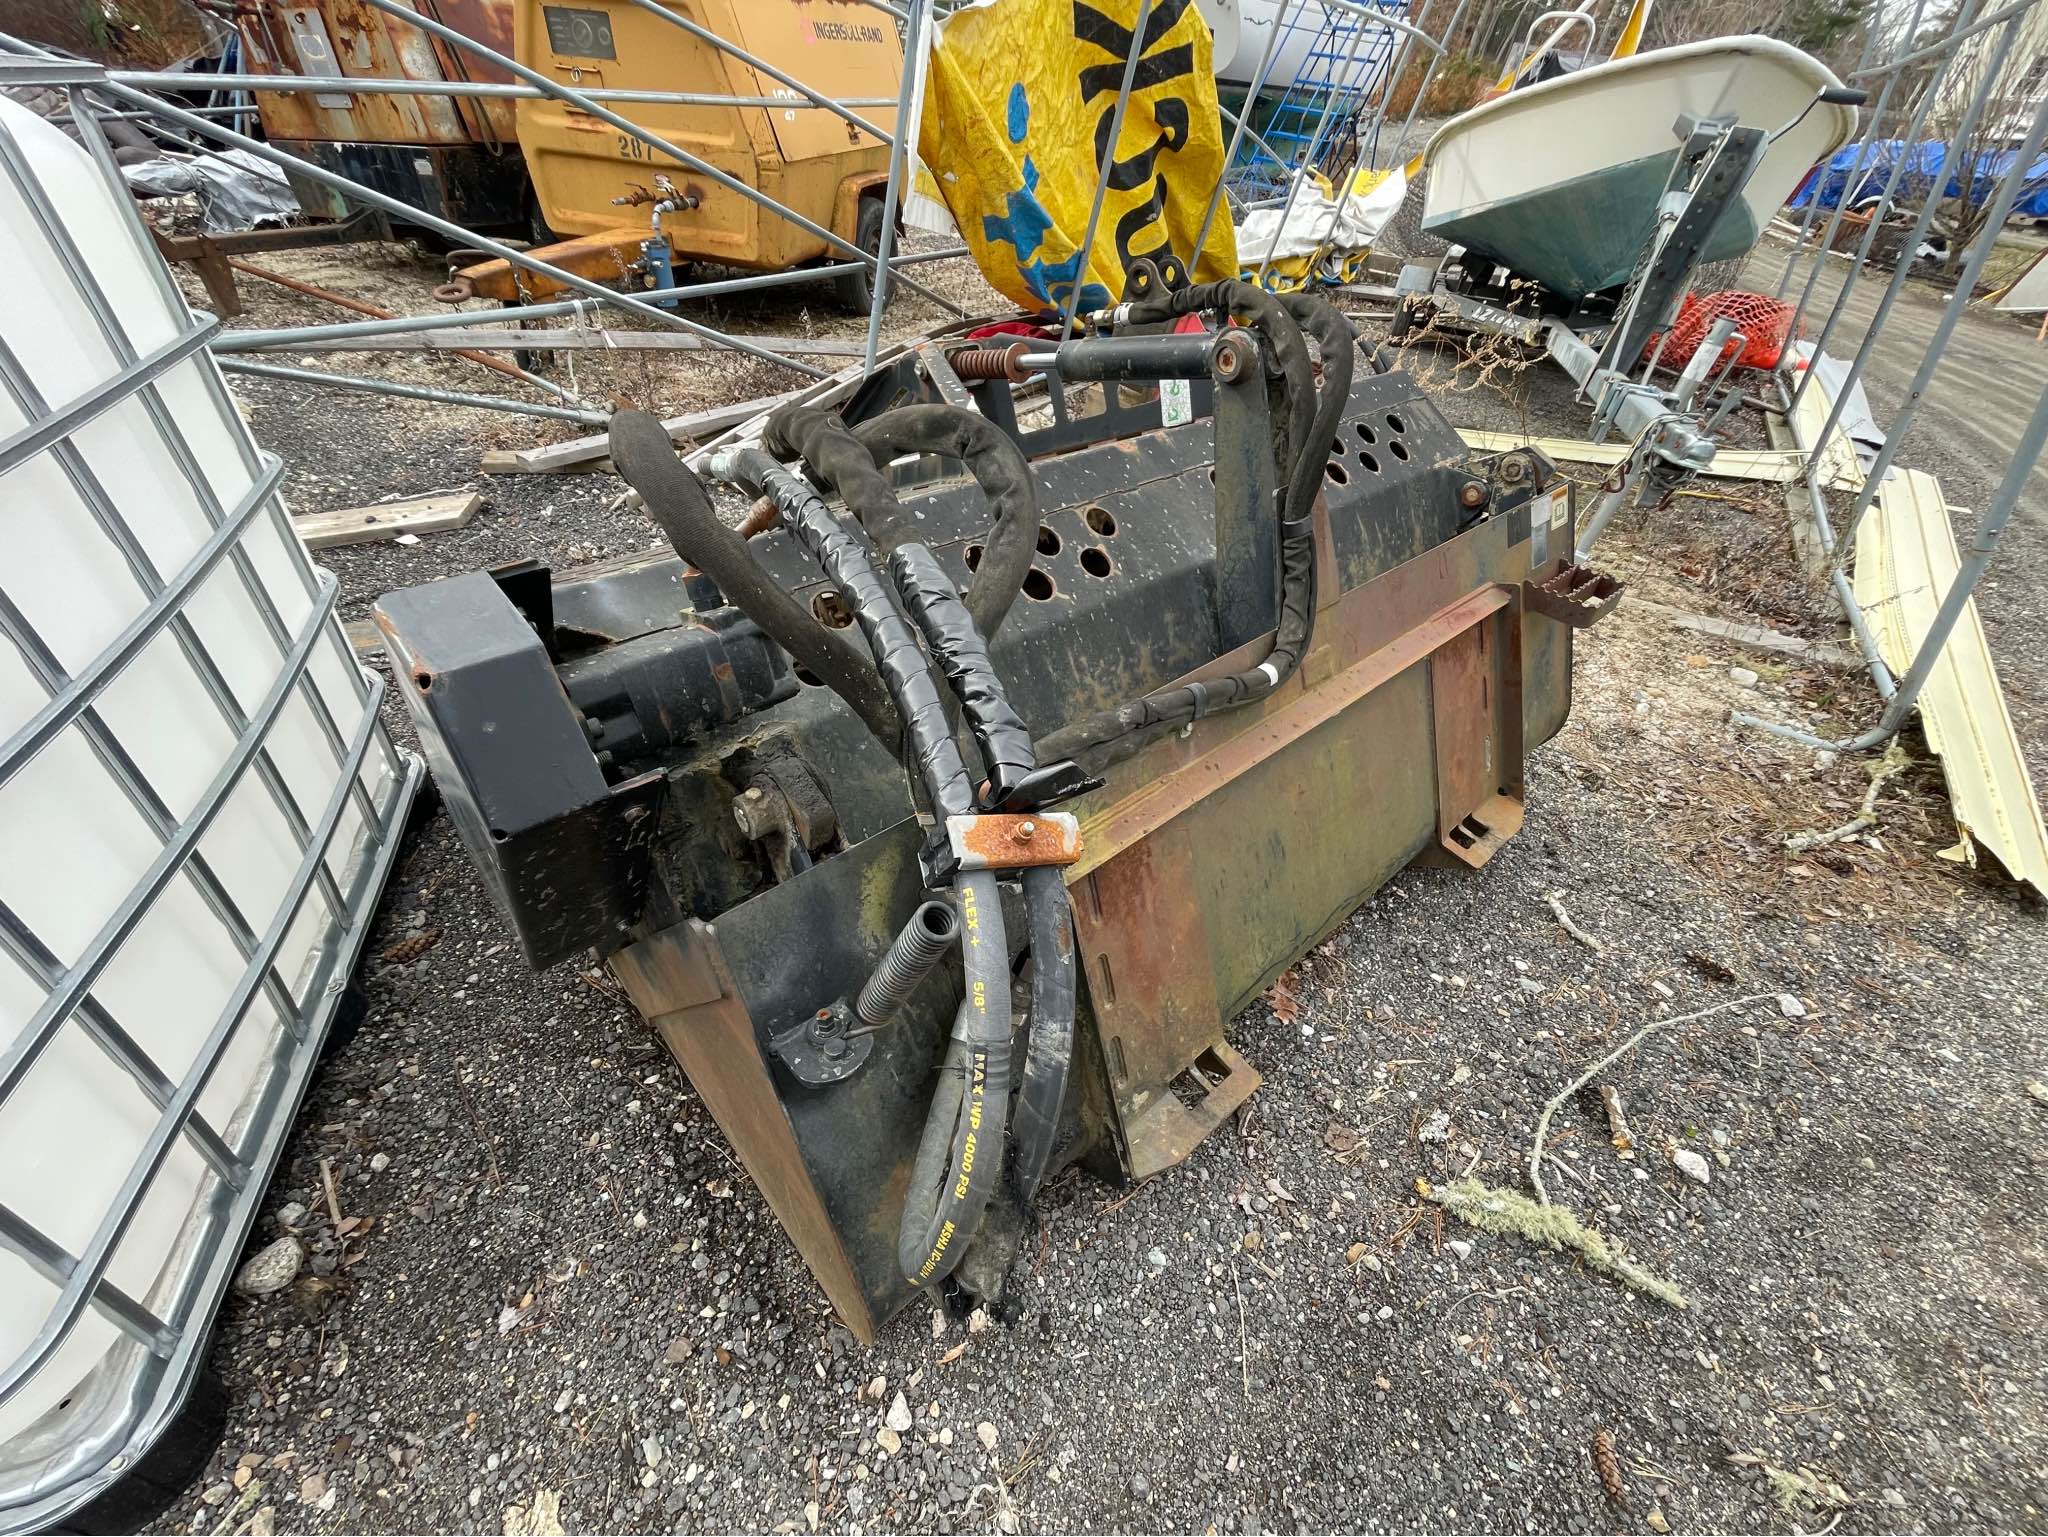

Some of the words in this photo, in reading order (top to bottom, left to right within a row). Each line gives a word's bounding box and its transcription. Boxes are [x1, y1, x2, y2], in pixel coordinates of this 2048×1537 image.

[963, 887, 979, 929] FLEX
[974, 981, 986, 1014] 5/8"
[972, 1053, 986, 1096] MAX
[961, 1132, 977, 1173] 4000
[954, 1173, 970, 1200] PSI
[936, 1219, 956, 1251] MSHA
